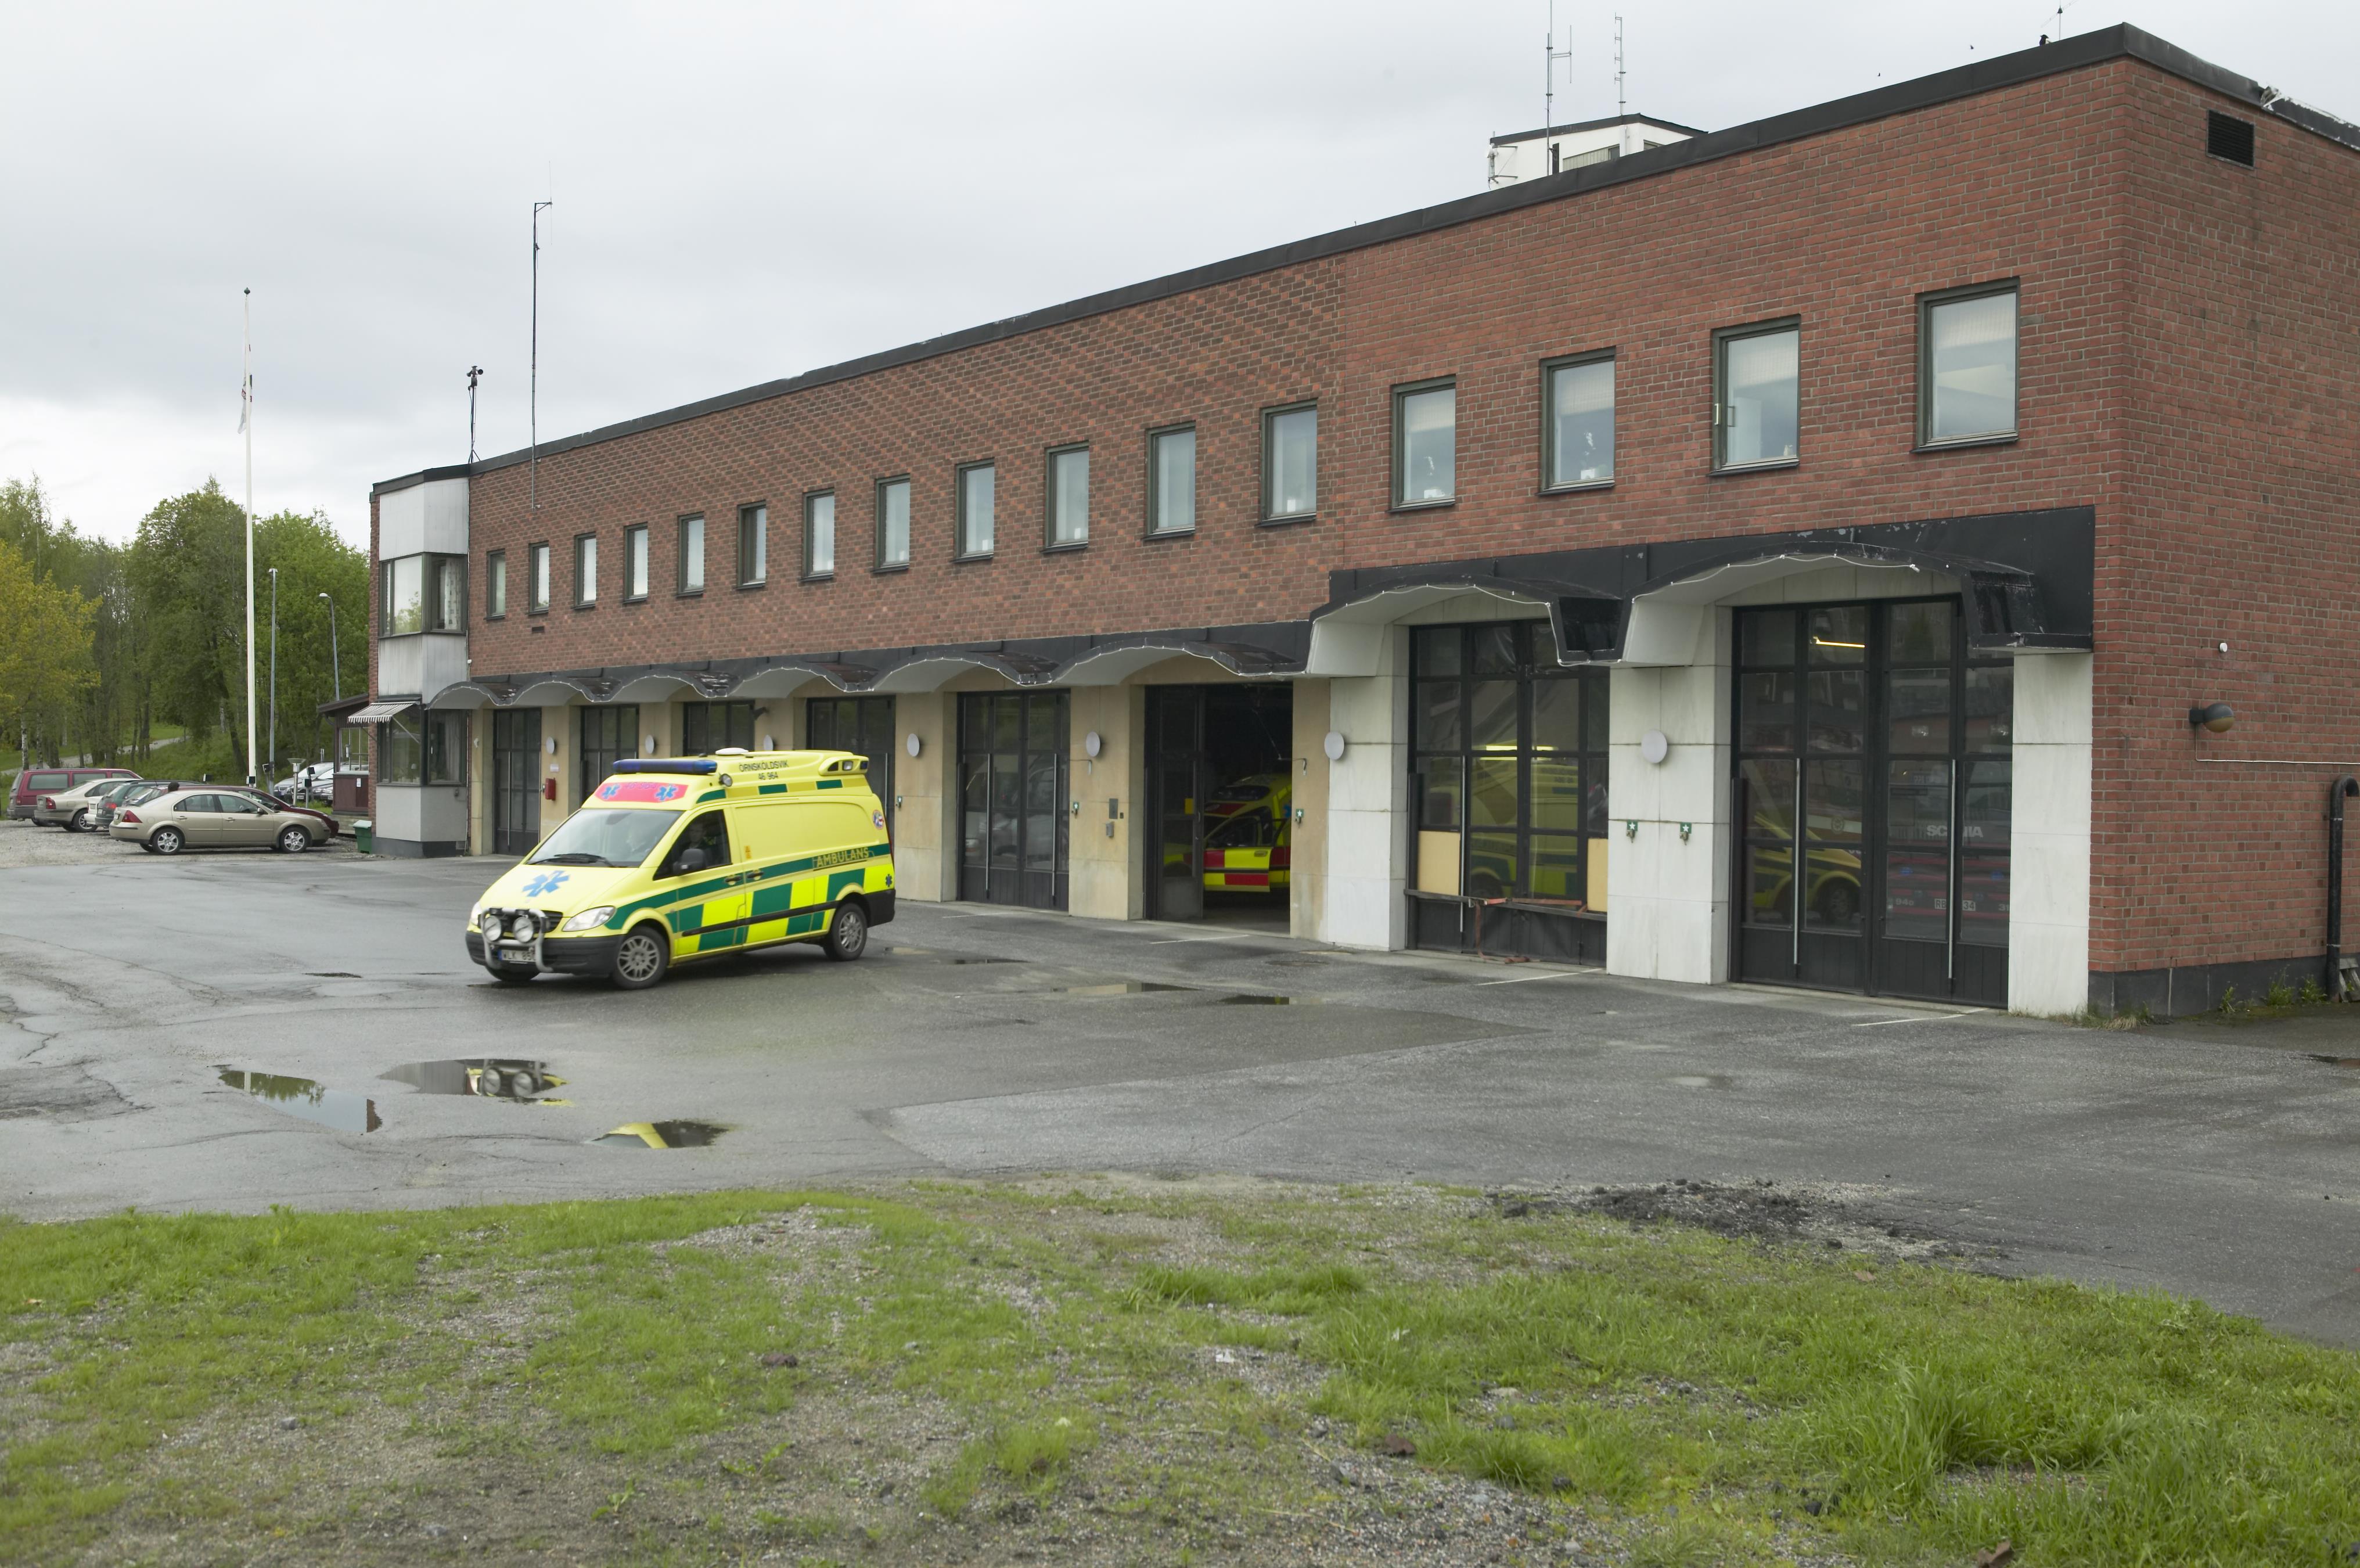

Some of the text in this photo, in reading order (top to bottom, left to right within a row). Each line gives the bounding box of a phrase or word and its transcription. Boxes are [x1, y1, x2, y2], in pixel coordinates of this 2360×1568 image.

[739, 760, 789, 772] ÖRNSKÖLDSVIK
[1926, 825, 1984, 838] SCIA
[817, 847, 869, 868] AMBULANS
